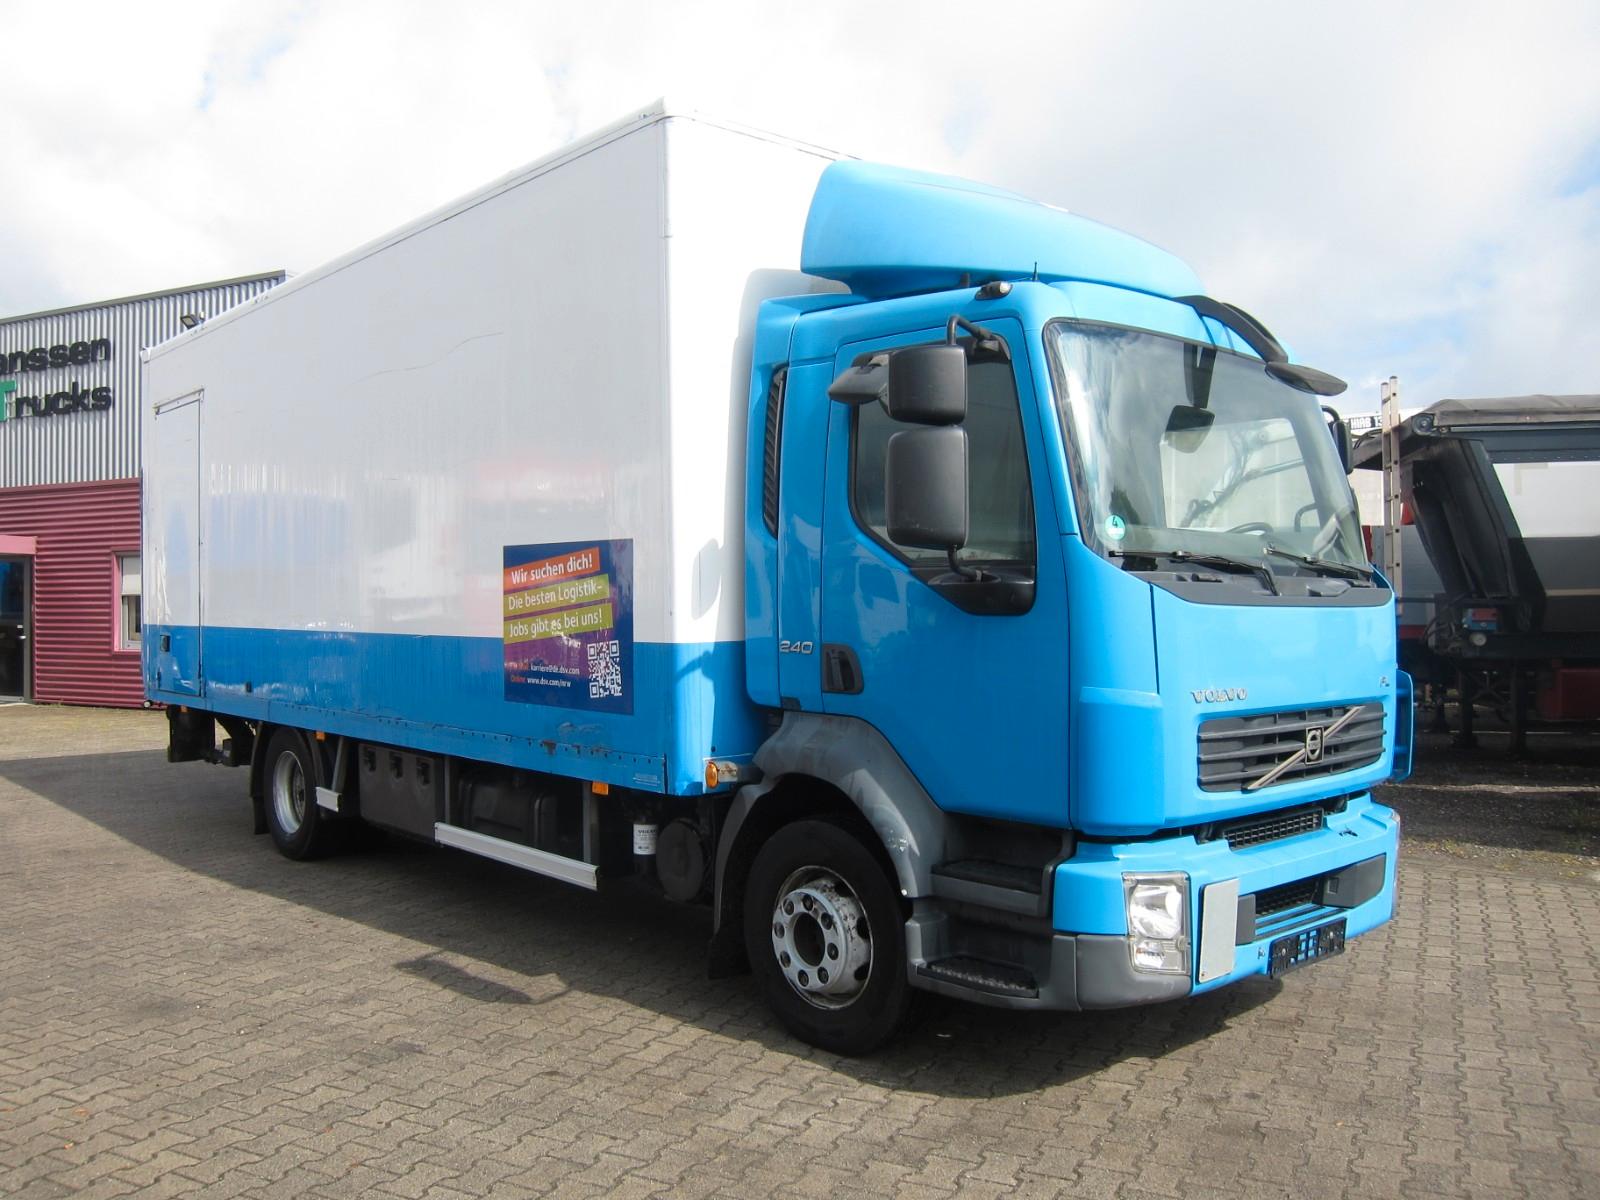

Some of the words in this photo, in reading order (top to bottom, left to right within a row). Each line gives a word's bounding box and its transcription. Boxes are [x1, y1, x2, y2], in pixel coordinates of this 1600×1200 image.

[511, 568, 528, 584] Wir
[530, 562, 565, 581] suchen
[566, 553, 593, 573] dich!
[508, 595, 523, 611] Die
[524, 591, 556, 608] besten
[558, 579, 603, 603] Logistik-
[509, 621, 529, 637] Jobs
[530, 618, 549, 638] gibt
[551, 619, 561, 630] es
[563, 612, 579, 628] bei
[581, 607, 602, 624] uns!
[780, 640, 813, 655] 240
[1190, 688, 1248, 704] VOLVO
